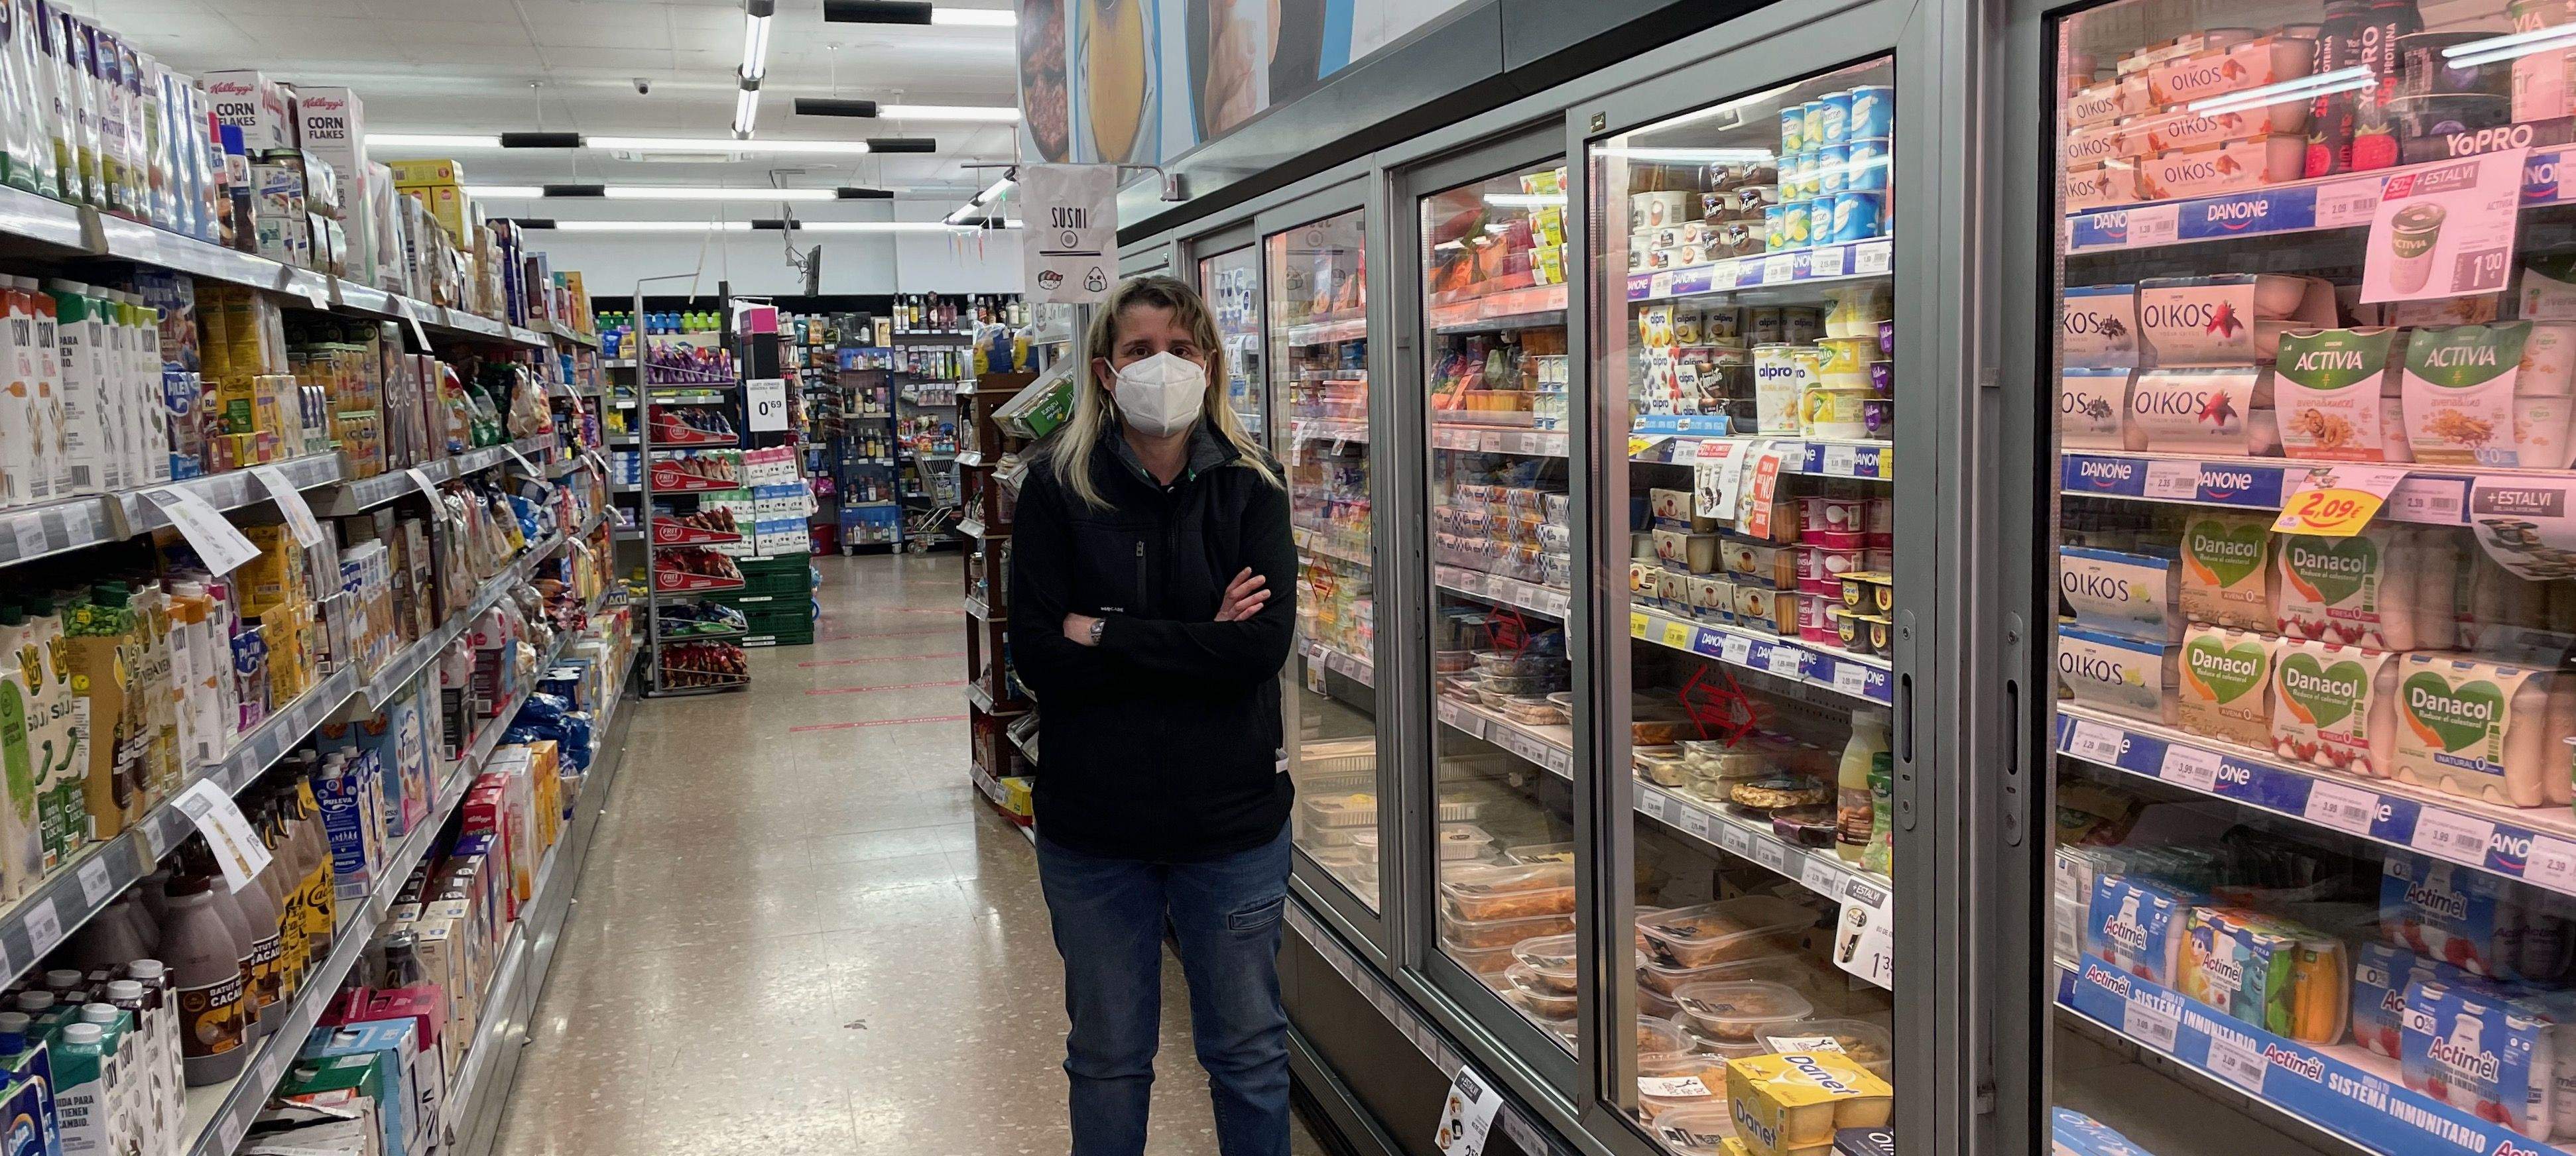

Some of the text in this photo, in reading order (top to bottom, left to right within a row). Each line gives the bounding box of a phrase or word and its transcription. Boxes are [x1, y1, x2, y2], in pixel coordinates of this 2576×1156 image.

[210, 82, 254, 95] Kellogg's
[2172, 67, 2222, 91] OIKOS
[216, 103, 255, 116] CORN
[302, 97, 345, 109] Kellogg's
[2077, 97, 2114, 119] OIKOS
[217, 117, 256, 127] FLAKES
[307, 117, 344, 129] CORN
[2168, 115, 2218, 138] OIKOS
[309, 130, 344, 139] FLAKES
[2445, 124, 2534, 157] YoPRO
[2068, 138, 2111, 159] OIKOS
[2164, 161, 2216, 184] OIKOS
[2065, 180, 2096, 198] IKOS
[1052, 207, 1087, 229] SUSHI
[2093, 212, 2127, 230] DANO
[1650, 312, 1665, 324] alpro
[1677, 315, 1696, 324] alpro
[1713, 314, 1733, 323] alpro
[2144, 303, 2213, 329] OIKOS
[1653, 357, 1668, 369] alpro
[2294, 351, 2363, 372] ACTIVIA
[2424, 346, 2496, 369] ACTIVIA
[1679, 373, 1695, 385] alpro
[1759, 363, 1793, 380] alpro
[1653, 399, 1669, 411] alpro
[2135, 390, 2207, 416] OIKOS
[2195, 534, 2258, 557] Danacol
[2294, 547, 2368, 573] Danacol
[2063, 571, 2129, 602] OIKOS
[2331, 609, 2353, 618] FRESA
[1702, 633, 1724, 647] DANON
[2059, 652, 2123, 685] OIKOS
[2192, 648, 2257, 676] Danacol
[2287, 667, 2358, 698] Danacol
[2411, 687, 2492, 721] Danacol
[2437, 754, 2474, 769] NATURAL
[323, 797, 352, 807] PULEVA
[2406, 882, 2467, 919] Actimel
[2105, 916, 2146, 950] Actimel
[2202, 953, 2242, 983] Actimel
[2086, 965, 2130, 997] Actimel
[2134, 989, 2257, 1053] SISTEMA INMUNITARIO
[2264, 1043, 2323, 1082] Actimel
[2428, 1037, 2498, 1084] Actimel
[1784, 1055, 1860, 1096] Danet
[74, 1096, 94, 1106] PARA
[61, 1108, 88, 1118] TIENEN
[2329, 1072, 2486, 1154] SISTEMA INMUNITARIO
[1735, 1097, 1777, 1152] Danet
